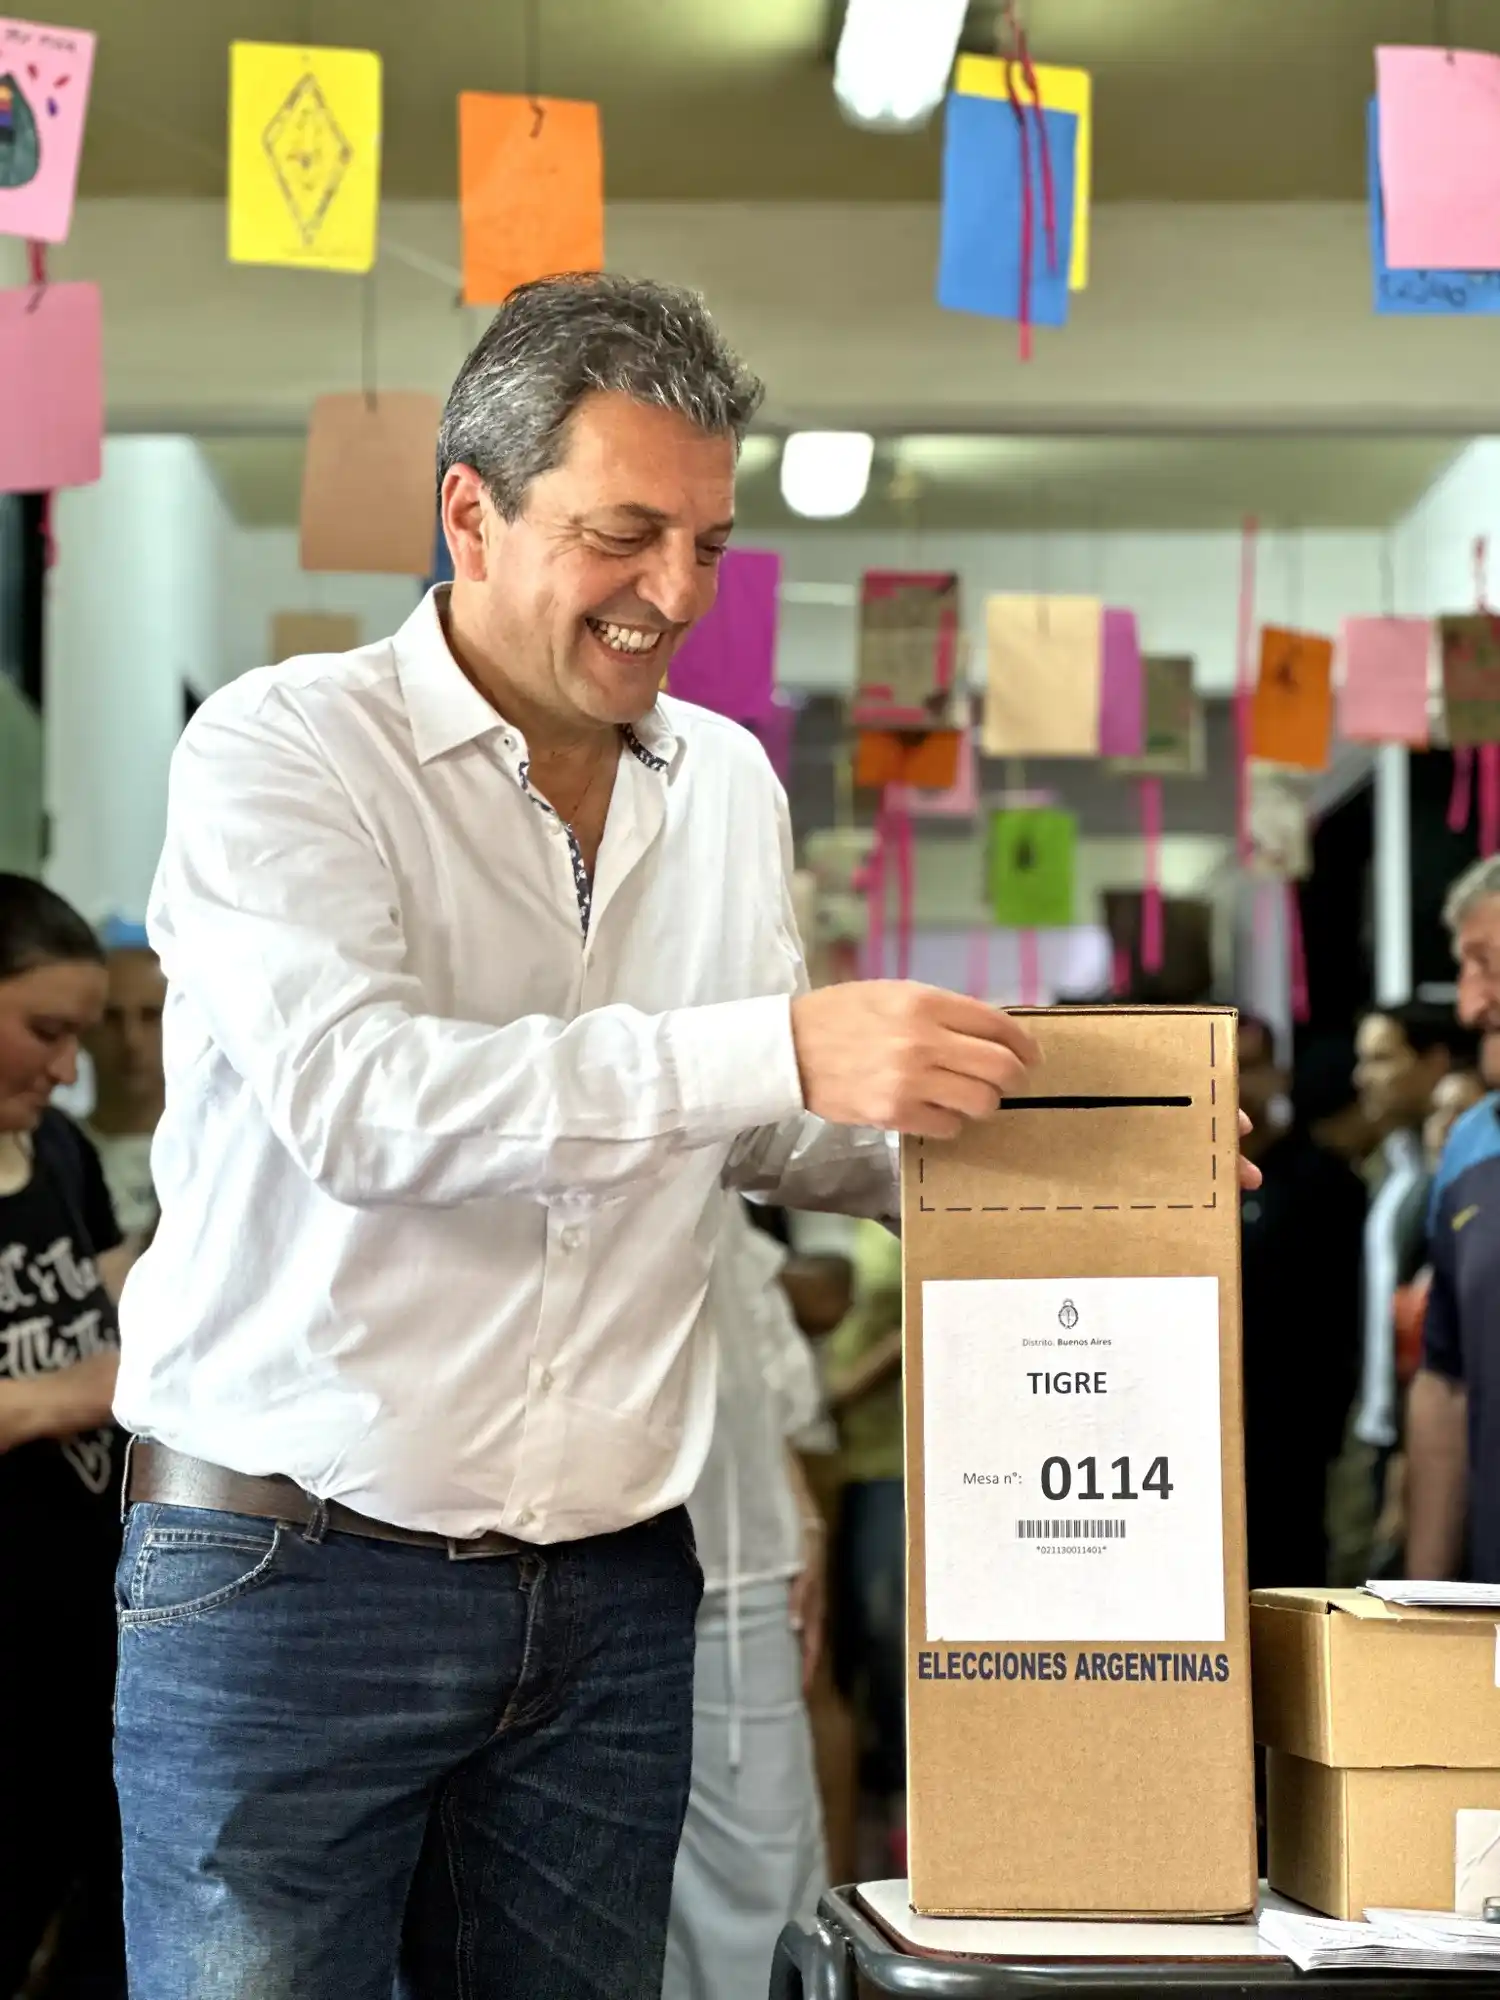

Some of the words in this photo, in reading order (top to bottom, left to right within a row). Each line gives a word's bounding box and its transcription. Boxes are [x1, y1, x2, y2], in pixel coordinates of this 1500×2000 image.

[1057, 1337, 1089, 1347] Buenos
[1090, 1337, 1112, 1346] Aires
[1026, 1371, 1108, 1395] TIGRE
[962, 1471, 999, 1485] Mesa
[1040, 1455, 1174, 1501] 0114
[918, 1651, 1067, 1682] ELECCIONES
[1074, 1651, 1230, 1682] ARGENTINAS
